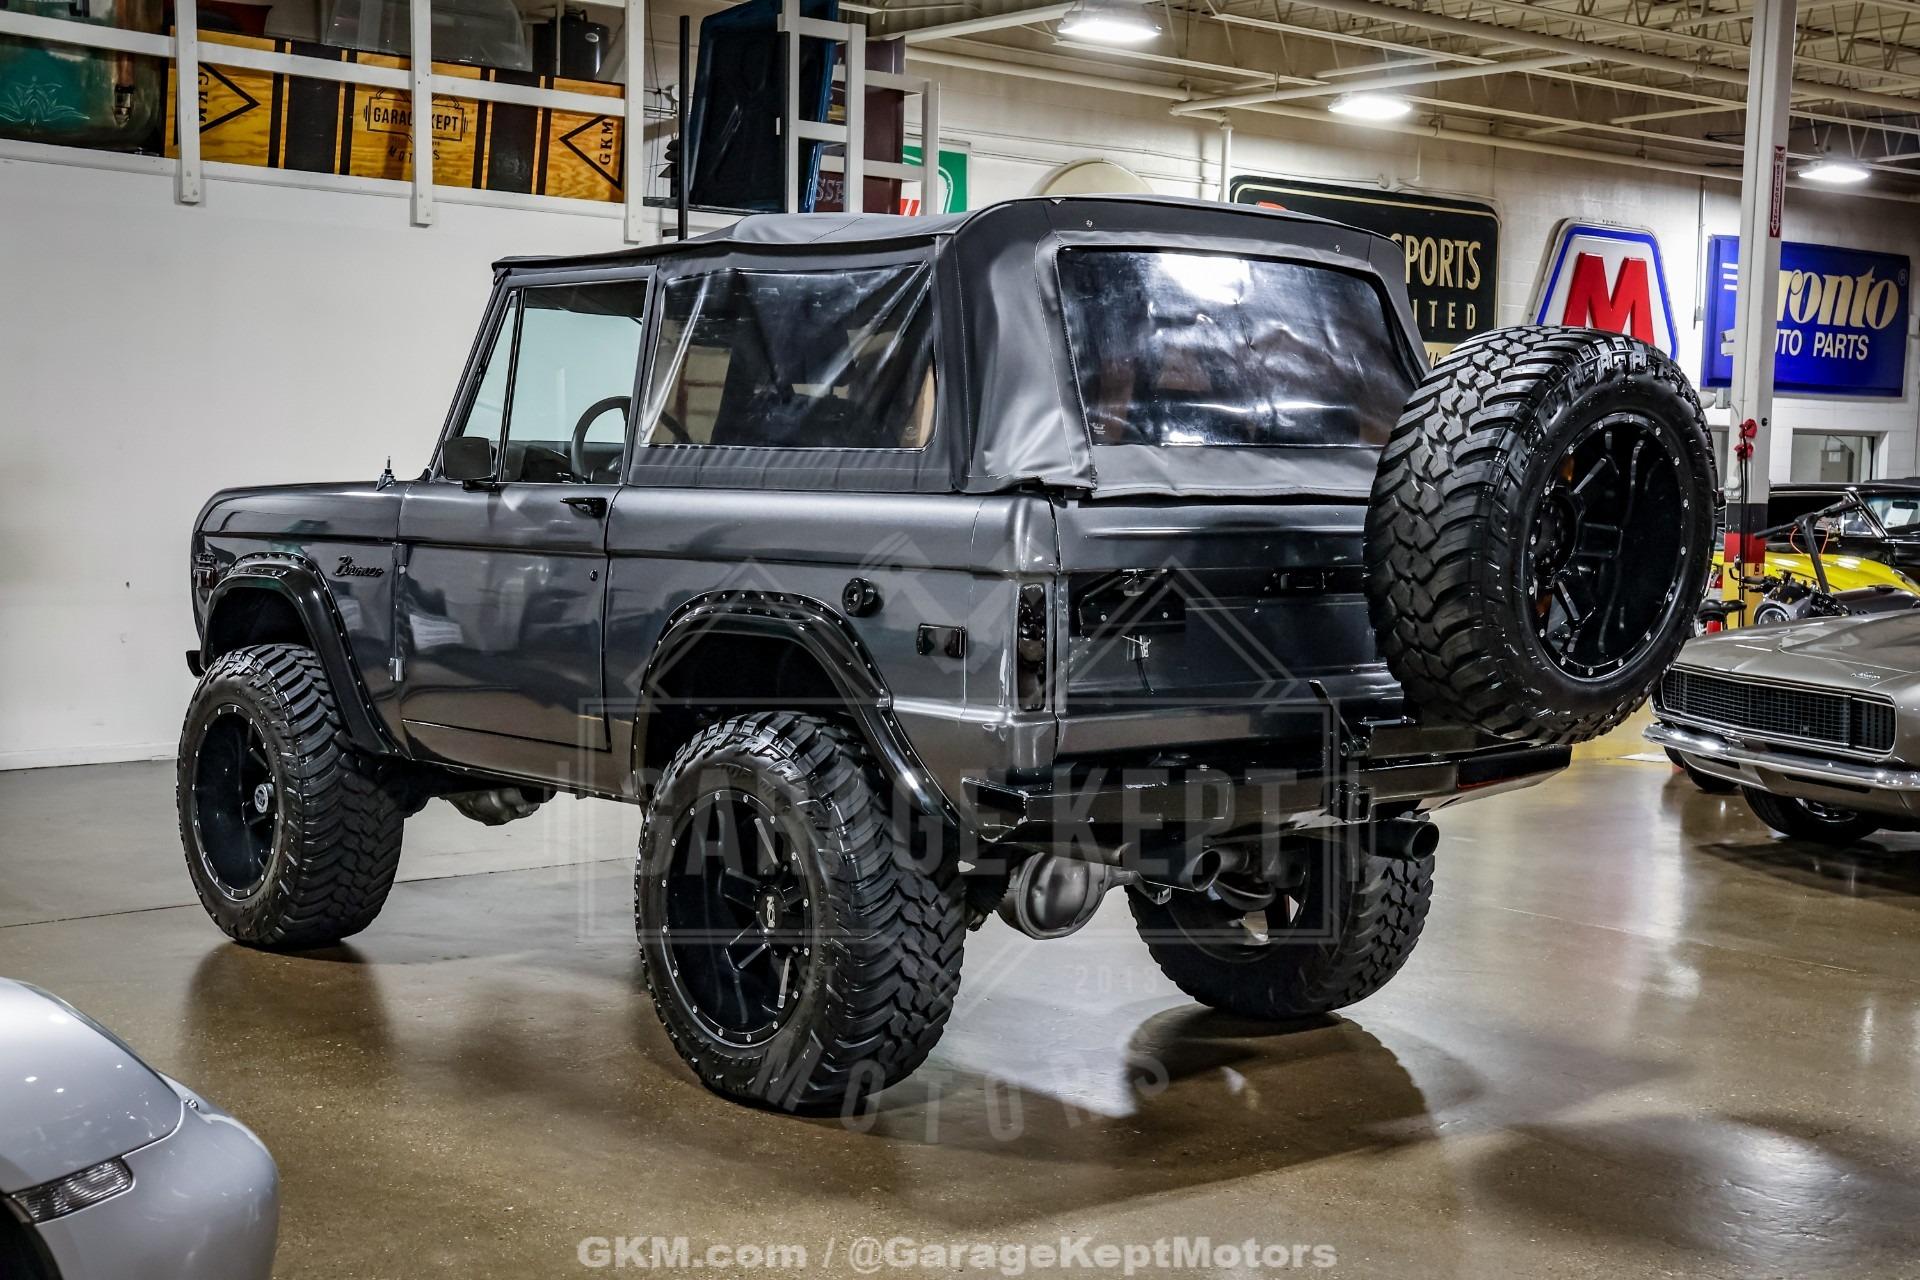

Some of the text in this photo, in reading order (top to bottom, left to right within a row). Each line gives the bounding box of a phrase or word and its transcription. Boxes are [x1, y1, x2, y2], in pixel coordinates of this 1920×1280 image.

[599, 121, 614, 166] GKM
[1391, 233, 1481, 290] PORTS
[1812, 331, 1869, 361] PARTS
[335, 556, 384, 578] Bronco
